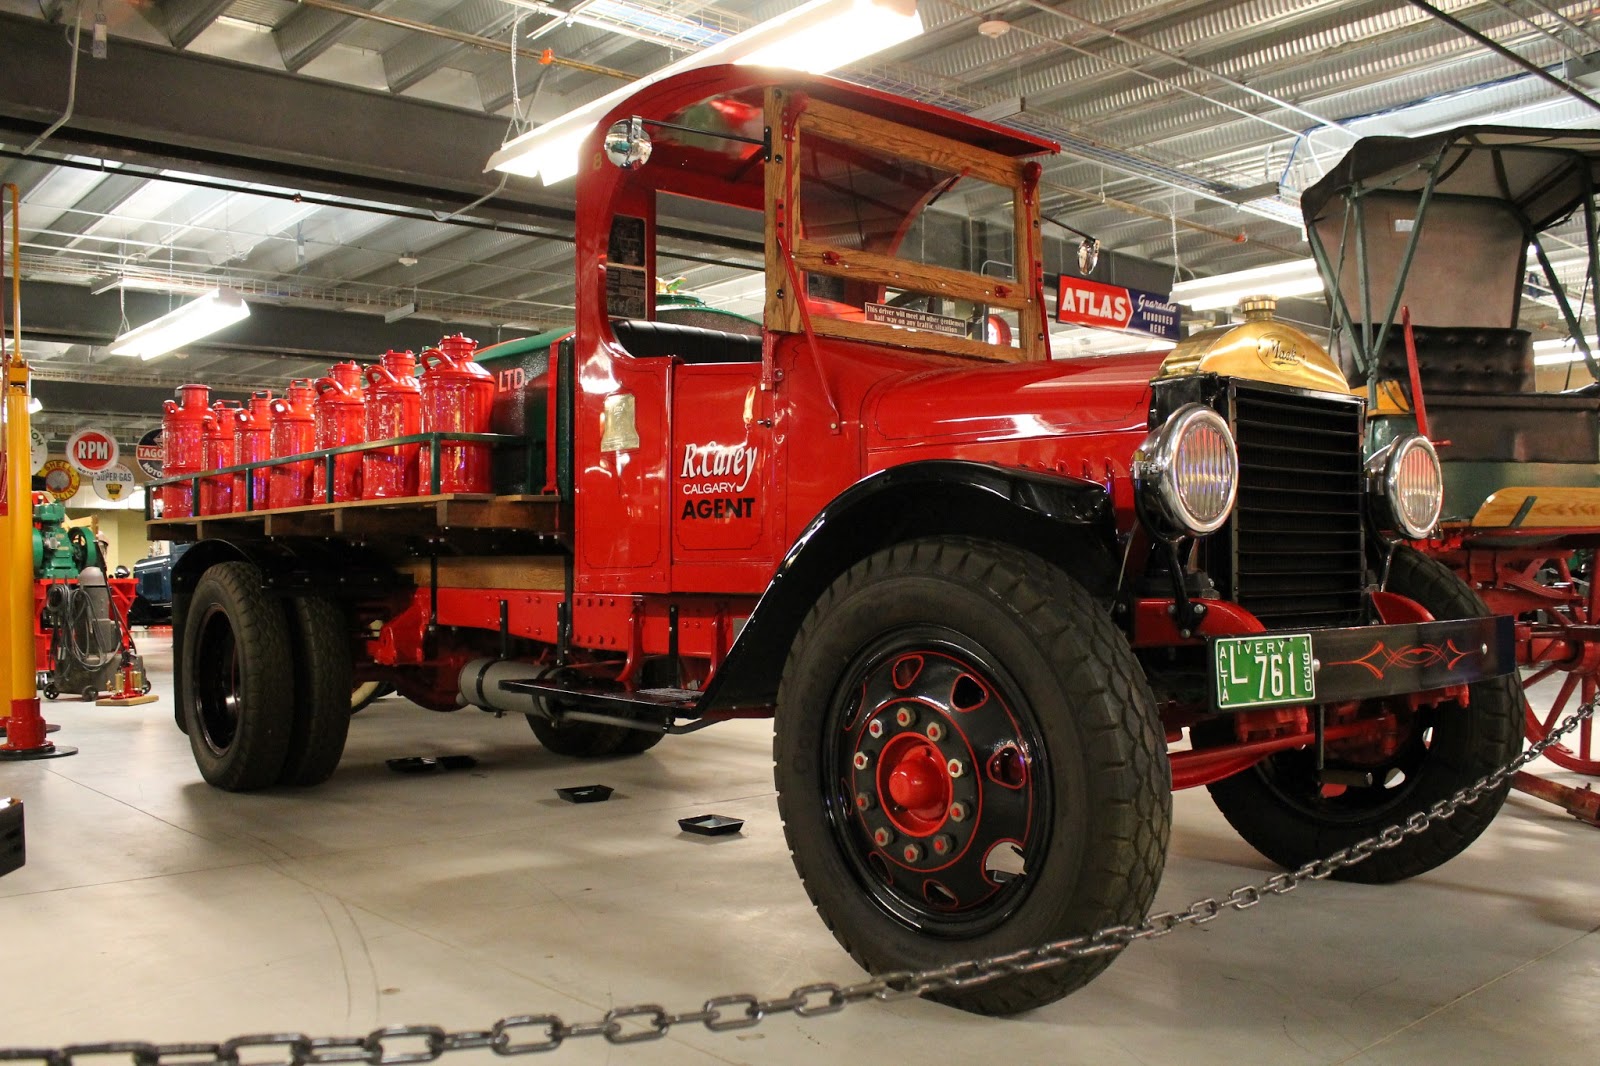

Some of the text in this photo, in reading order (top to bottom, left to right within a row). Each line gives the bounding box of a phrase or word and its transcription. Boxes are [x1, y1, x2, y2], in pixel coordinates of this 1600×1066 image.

[1061, 287, 1127, 322] ATLAS
[1137, 294, 1177, 313] Guarantee
[867, 305, 878, 314] This
[879, 307, 895, 316] driver
[896, 309, 905, 317] will
[926, 315, 939, 323] other
[940, 317, 965, 328] gentlemen
[874, 314, 885, 322] half
[887, 317, 897, 325] way
[906, 319, 916, 327] any
[917, 321, 933, 330] traffic
[935, 324, 958, 333] situation
[1142, 311, 1174, 326] HONOURED
[1149, 323, 1166, 335] HERE
[1265, 339, 1299, 362] Mack
[498, 368, 528, 393] LTD.
[78, 440, 109, 461] RPM
[138, 447, 163, 459] TAGO
[44, 460, 71, 472] SHELL
[77, 467, 98, 476] MOTOR
[142, 462, 163, 478] MOTO
[52, 484, 78, 500] OLINE
[682, 481, 736, 496] CALGARY
[681, 497, 756, 521] AGENT
[1219, 646, 1230, 702] ALTA
[1302, 639, 1312, 692] 1930
